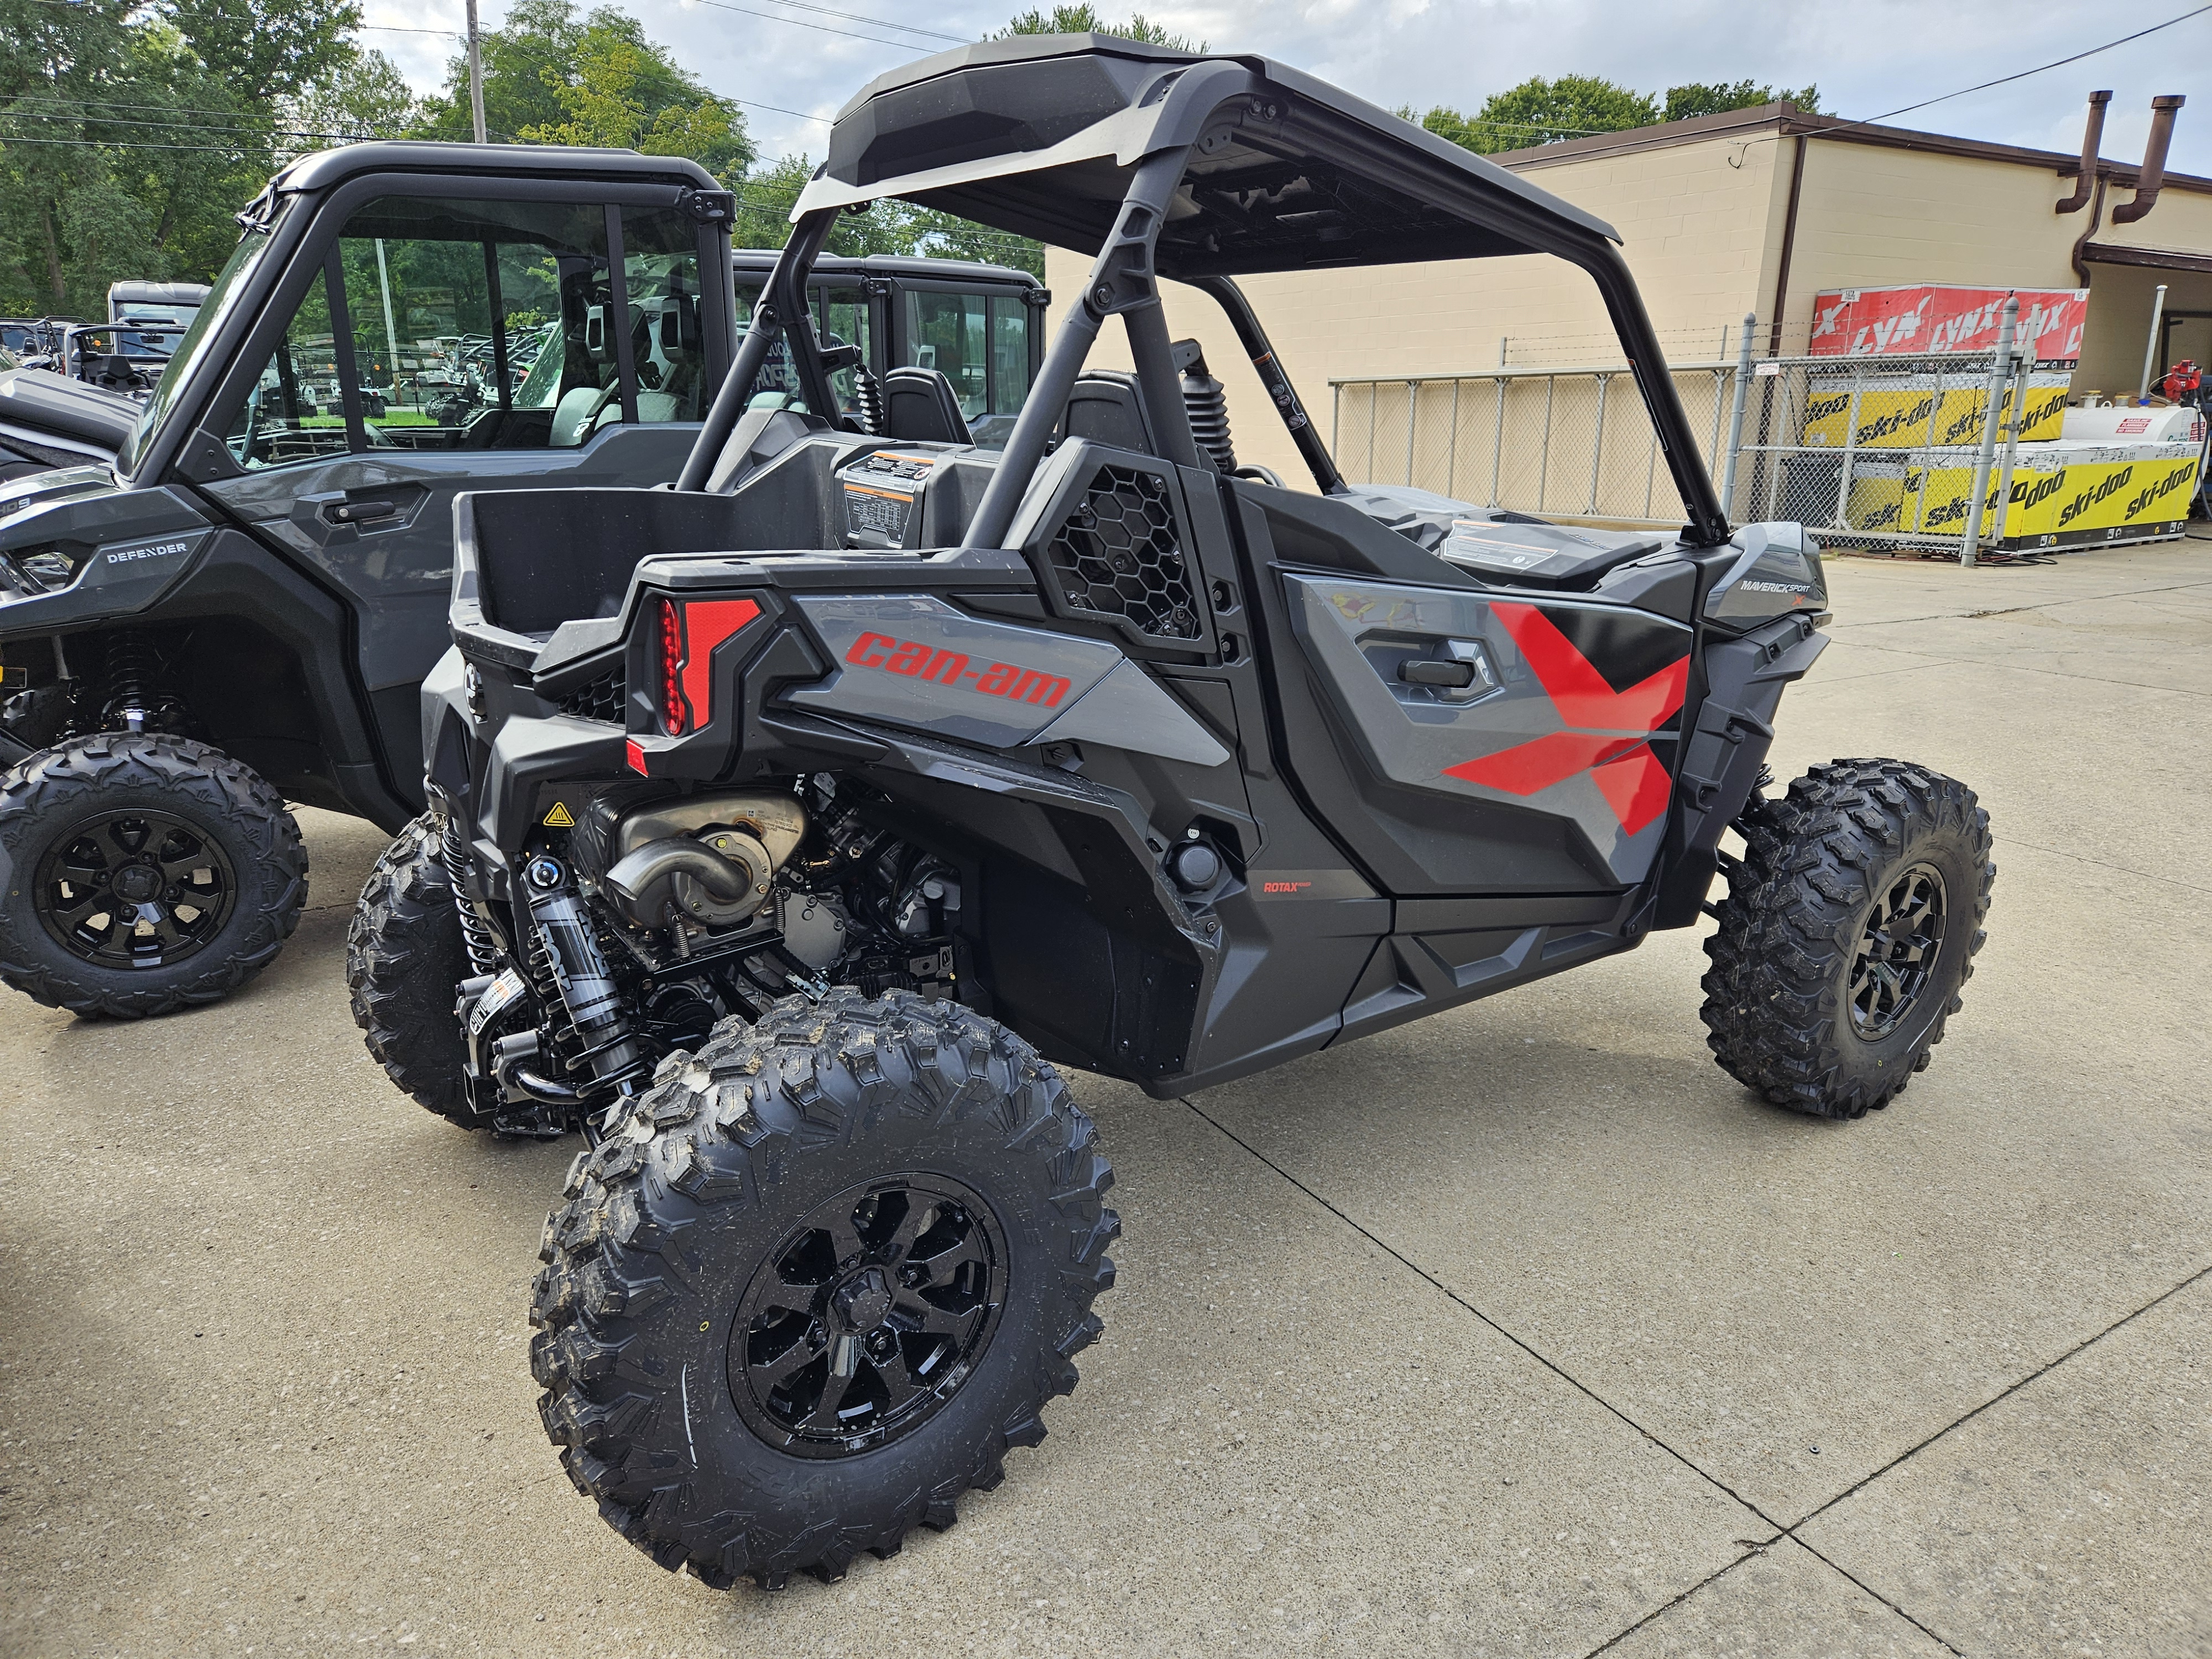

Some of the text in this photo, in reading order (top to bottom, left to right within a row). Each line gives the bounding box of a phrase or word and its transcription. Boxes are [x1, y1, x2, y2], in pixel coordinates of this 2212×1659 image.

[1929, 298, 2003, 352] LYNX
[2058, 466, 2133, 527] ski-doo
[2125, 461, 2195, 521] ski-doo
[107, 543, 187, 563] DEFENDER
[1740, 580, 1791, 593] MAVERICK
[845, 630, 1072, 709] can-am
[1264, 882, 1298, 893] ROTAX
